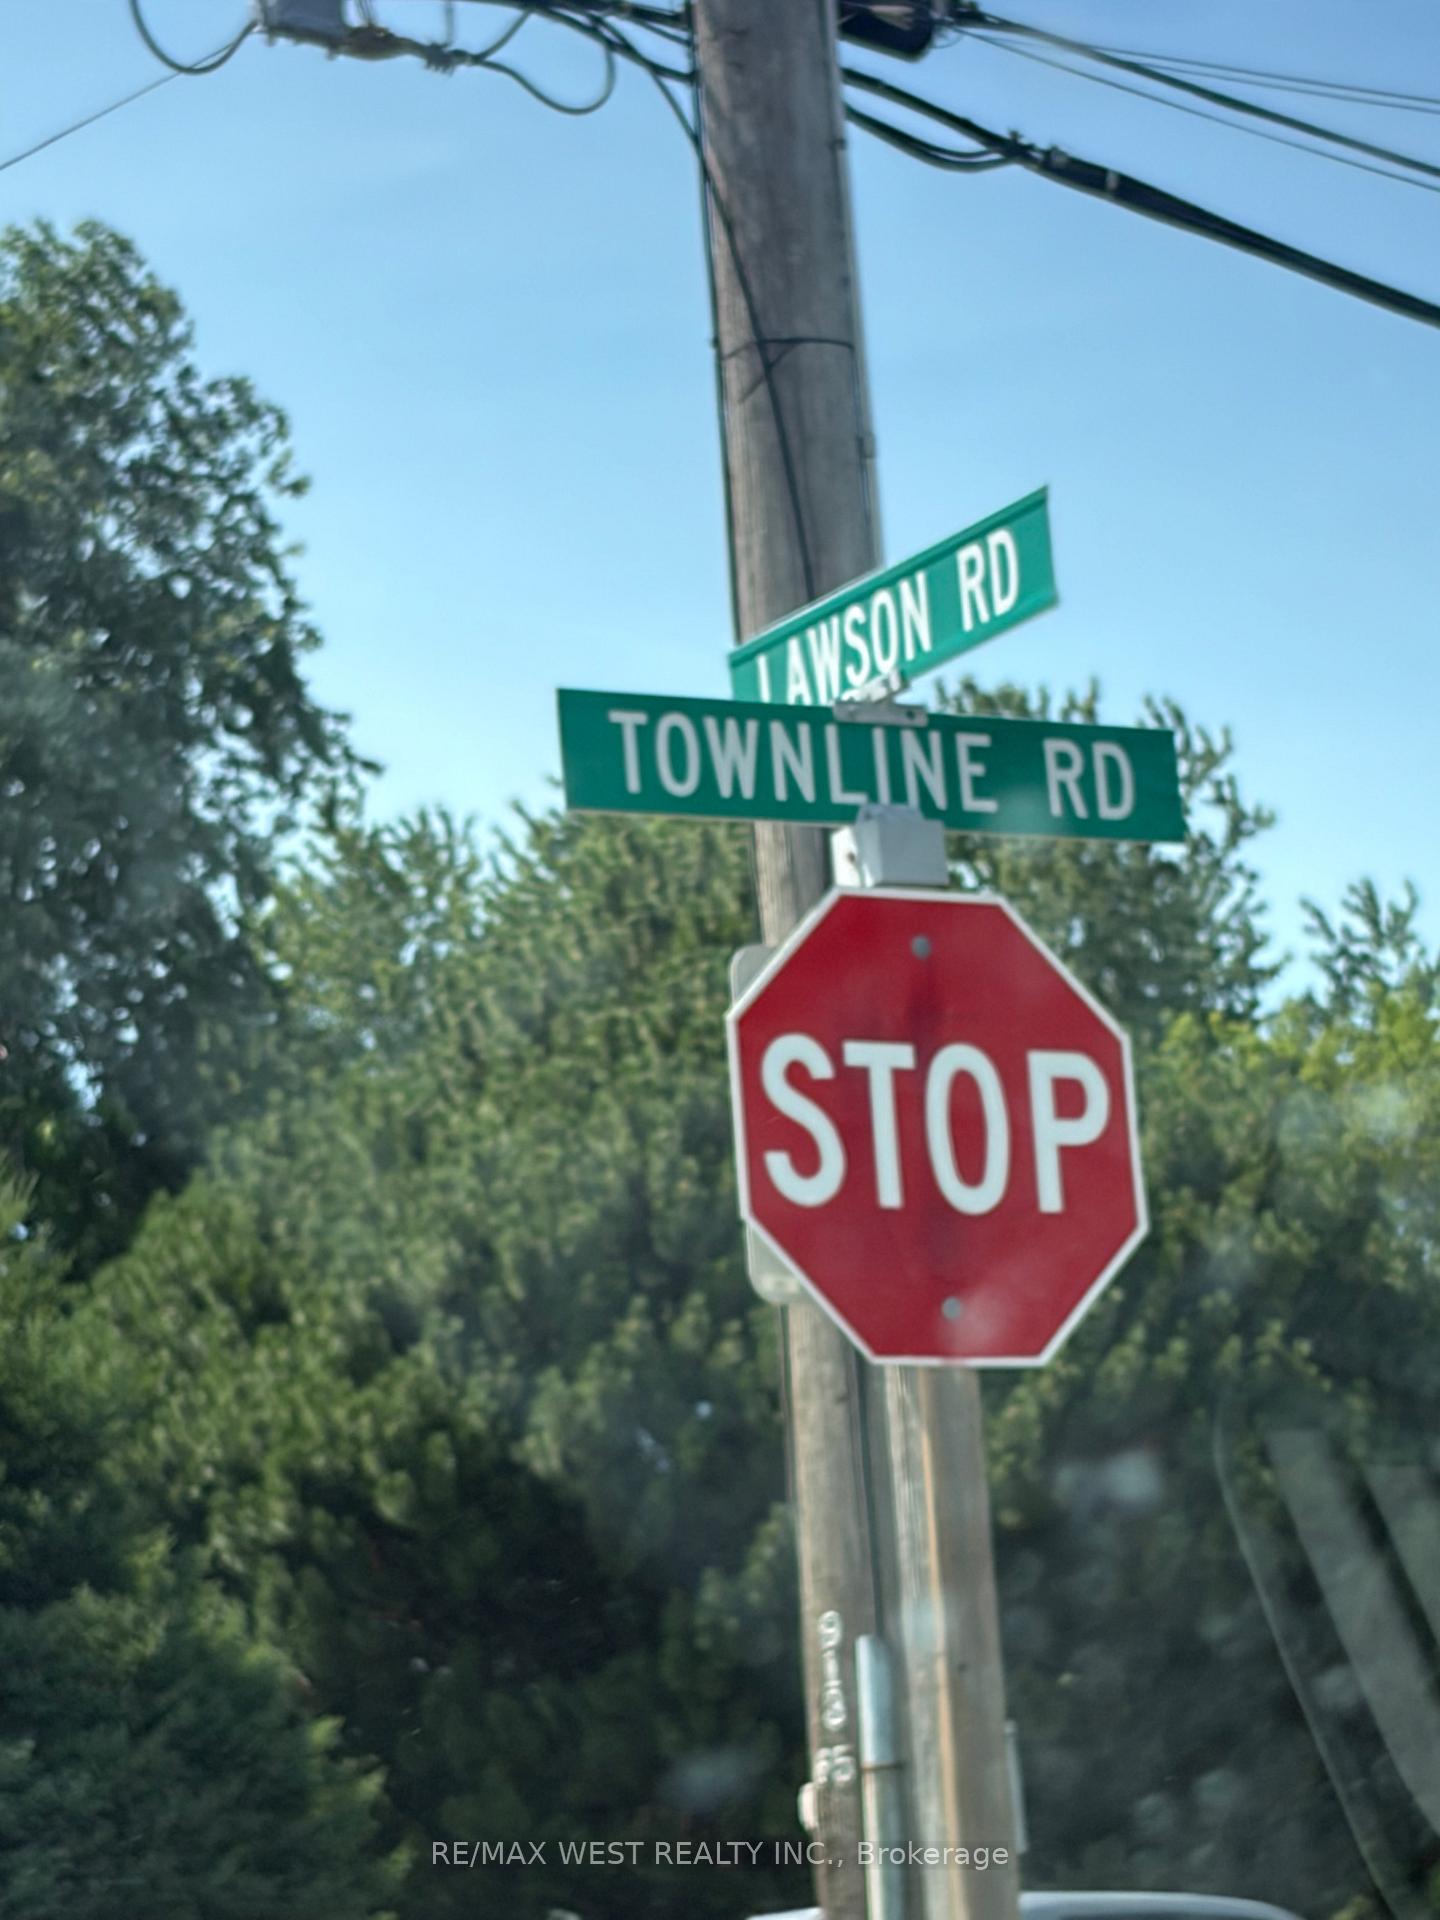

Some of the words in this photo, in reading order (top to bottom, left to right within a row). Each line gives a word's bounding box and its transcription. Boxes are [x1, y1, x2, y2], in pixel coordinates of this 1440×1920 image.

[957, 527, 1020, 633] RD
[608, 709, 998, 814] TOWNLINE
[1043, 737, 1136, 821] RD
[760, 1032, 1111, 1216] STOP
